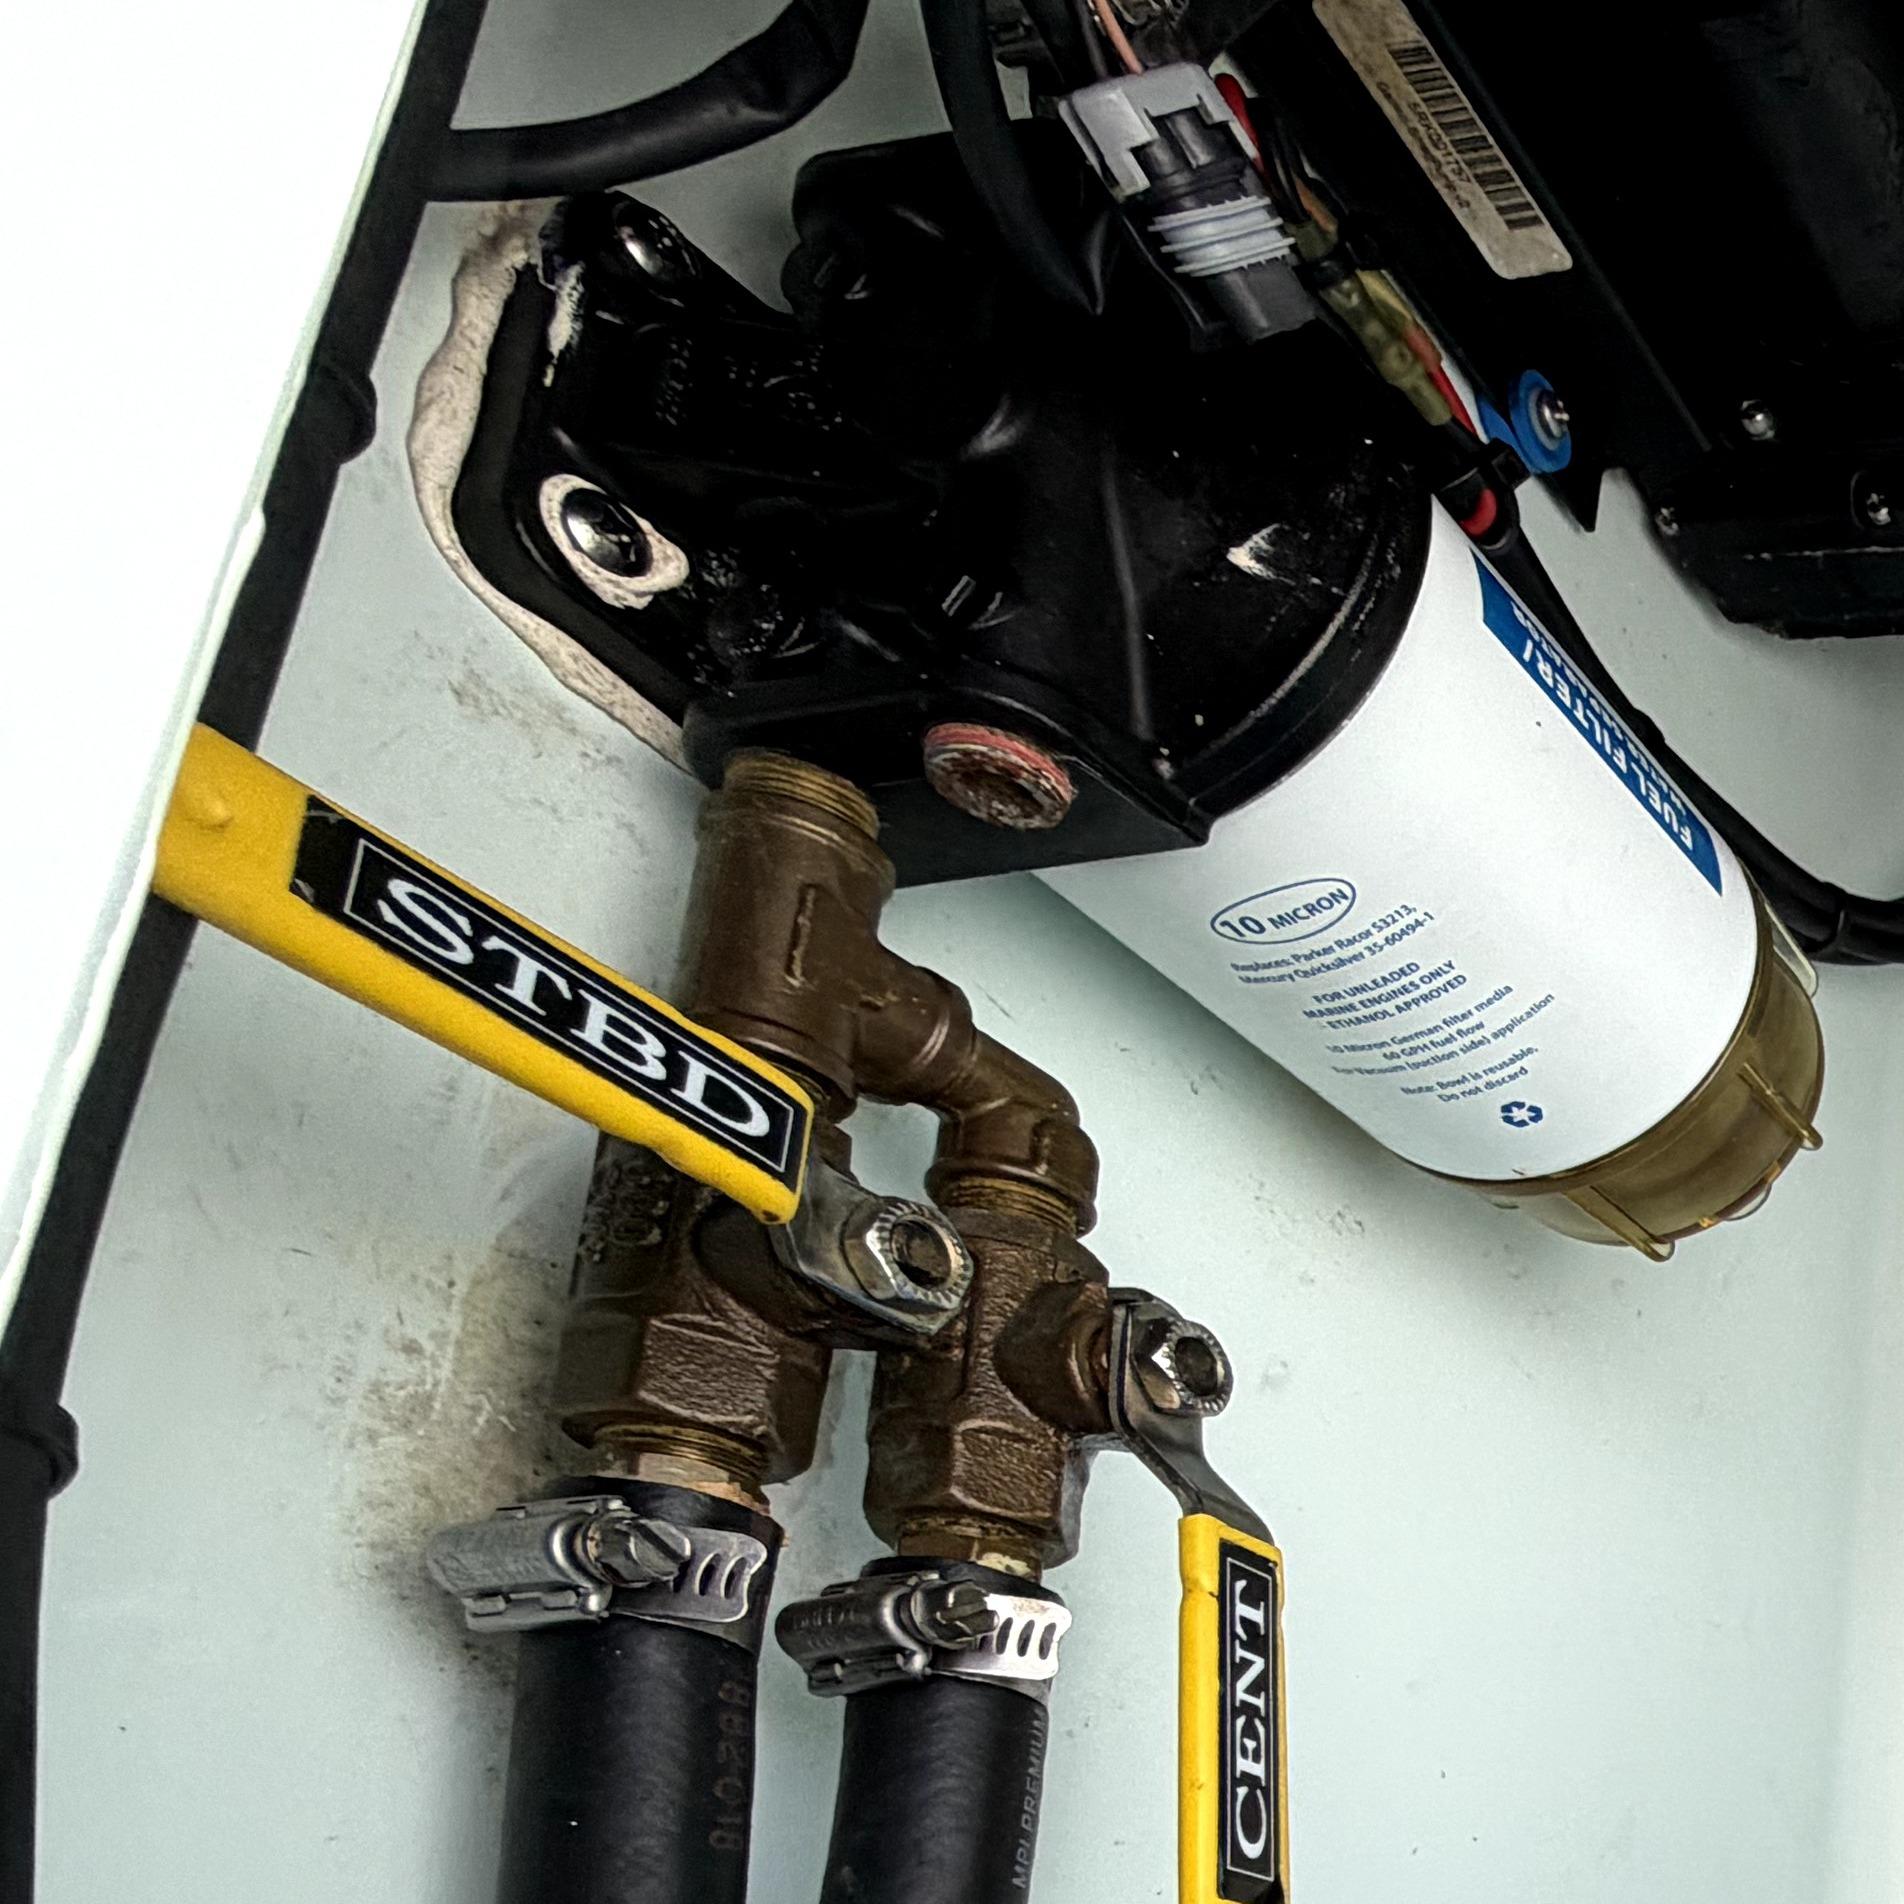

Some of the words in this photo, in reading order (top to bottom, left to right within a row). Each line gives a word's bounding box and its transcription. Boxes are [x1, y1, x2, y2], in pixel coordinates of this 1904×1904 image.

[1632, 761, 1692, 850] FUEL
[1219, 916, 1265, 937] 10
[1267, 888, 1349, 930] MICRON
[1291, 945, 1335, 965] Parker
[1335, 928, 1374, 950] Racor
[1293, 951, 1365, 978] Quicksilver
[1366, 911, 1434, 955] 35-60494-1
[377, 877, 770, 1138] STBD
[1303, 1001, 1359, 1018] MARINE
[1360, 979, 1420, 1009] ENGINES
[1419, 959, 1455, 985] ONLY
[1312, 990, 1344, 1003] FOR
[1345, 960, 1420, 997] UNLEADED
[1327, 1006, 1394, 1030] ETHANOL
[1395, 974, 1467, 1014] APPROVED
[1390, 1023, 1443, 1046] German
[1441, 1007, 1474, 1028] filter
[1474, 983, 1513, 1013] media
[1429, 1032, 1456, 1049] fuel
[1456, 1021, 1485, 1038] flow
[1458, 1033, 1491, 1054] side)
[1490, 992, 1555, 1041] application
[1436, 1073, 1470, 1089] Bowl
[1437, 1091, 1459, 1103] Do
[1460, 1083, 1483, 1097] not
[1483, 1066, 1528, 1091] discard
[1235, 1579, 1267, 1860] CENT
[1021, 1708, 1046, 1833] PREMIUM
